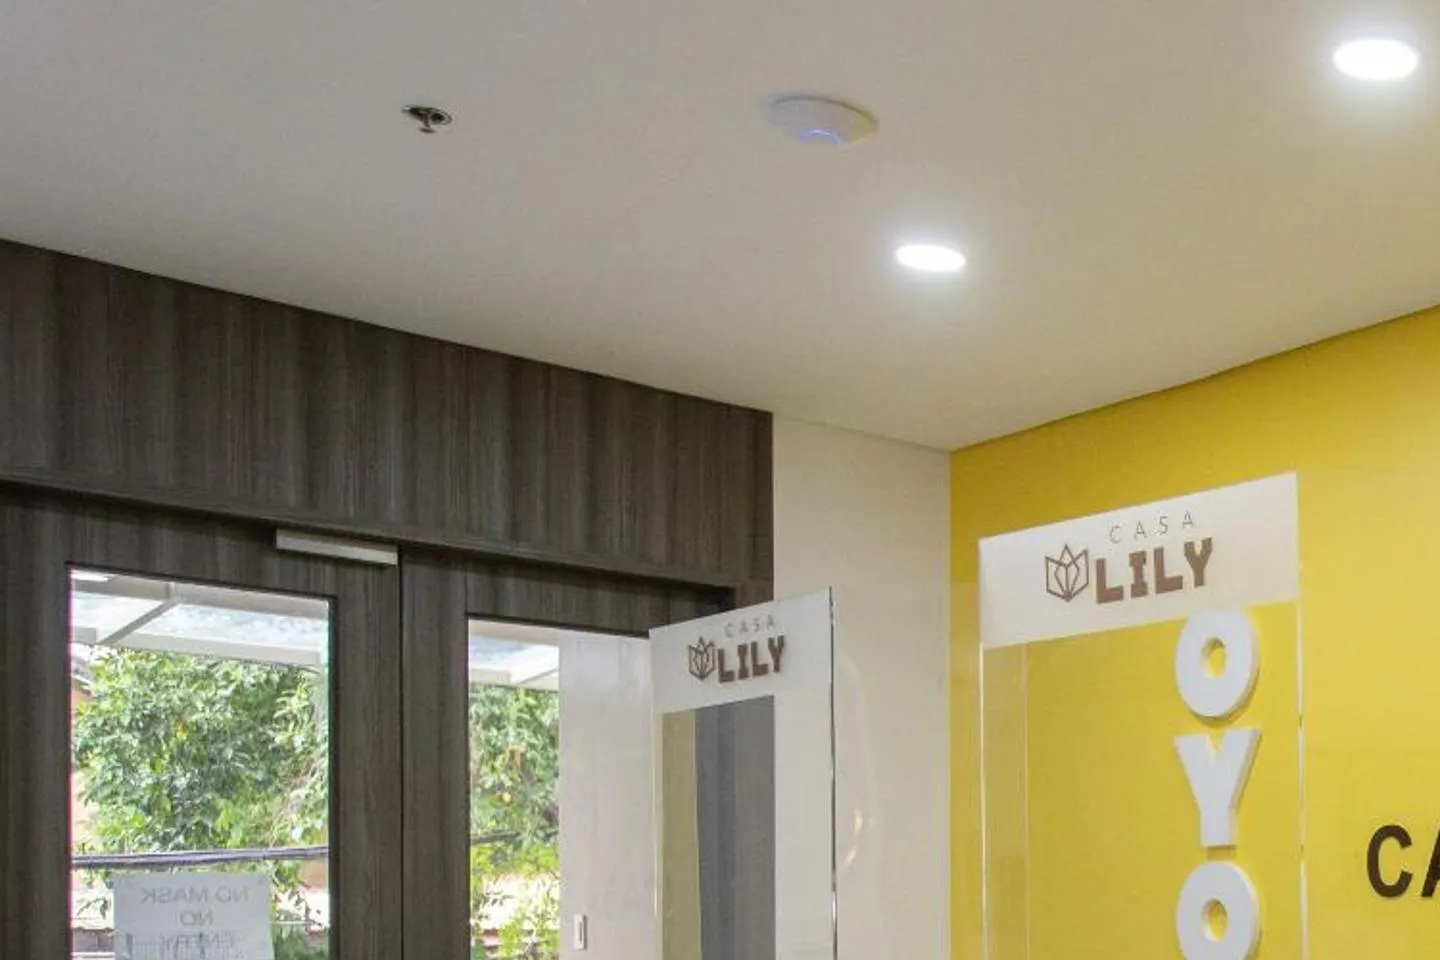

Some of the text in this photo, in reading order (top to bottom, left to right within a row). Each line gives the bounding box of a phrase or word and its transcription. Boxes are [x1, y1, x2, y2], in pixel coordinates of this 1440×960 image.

[1108, 510, 1196, 545] CASA
[1095, 536, 1214, 604] LILY
[724, 615, 777, 638] CASA
[717, 635, 786, 683] LILY
